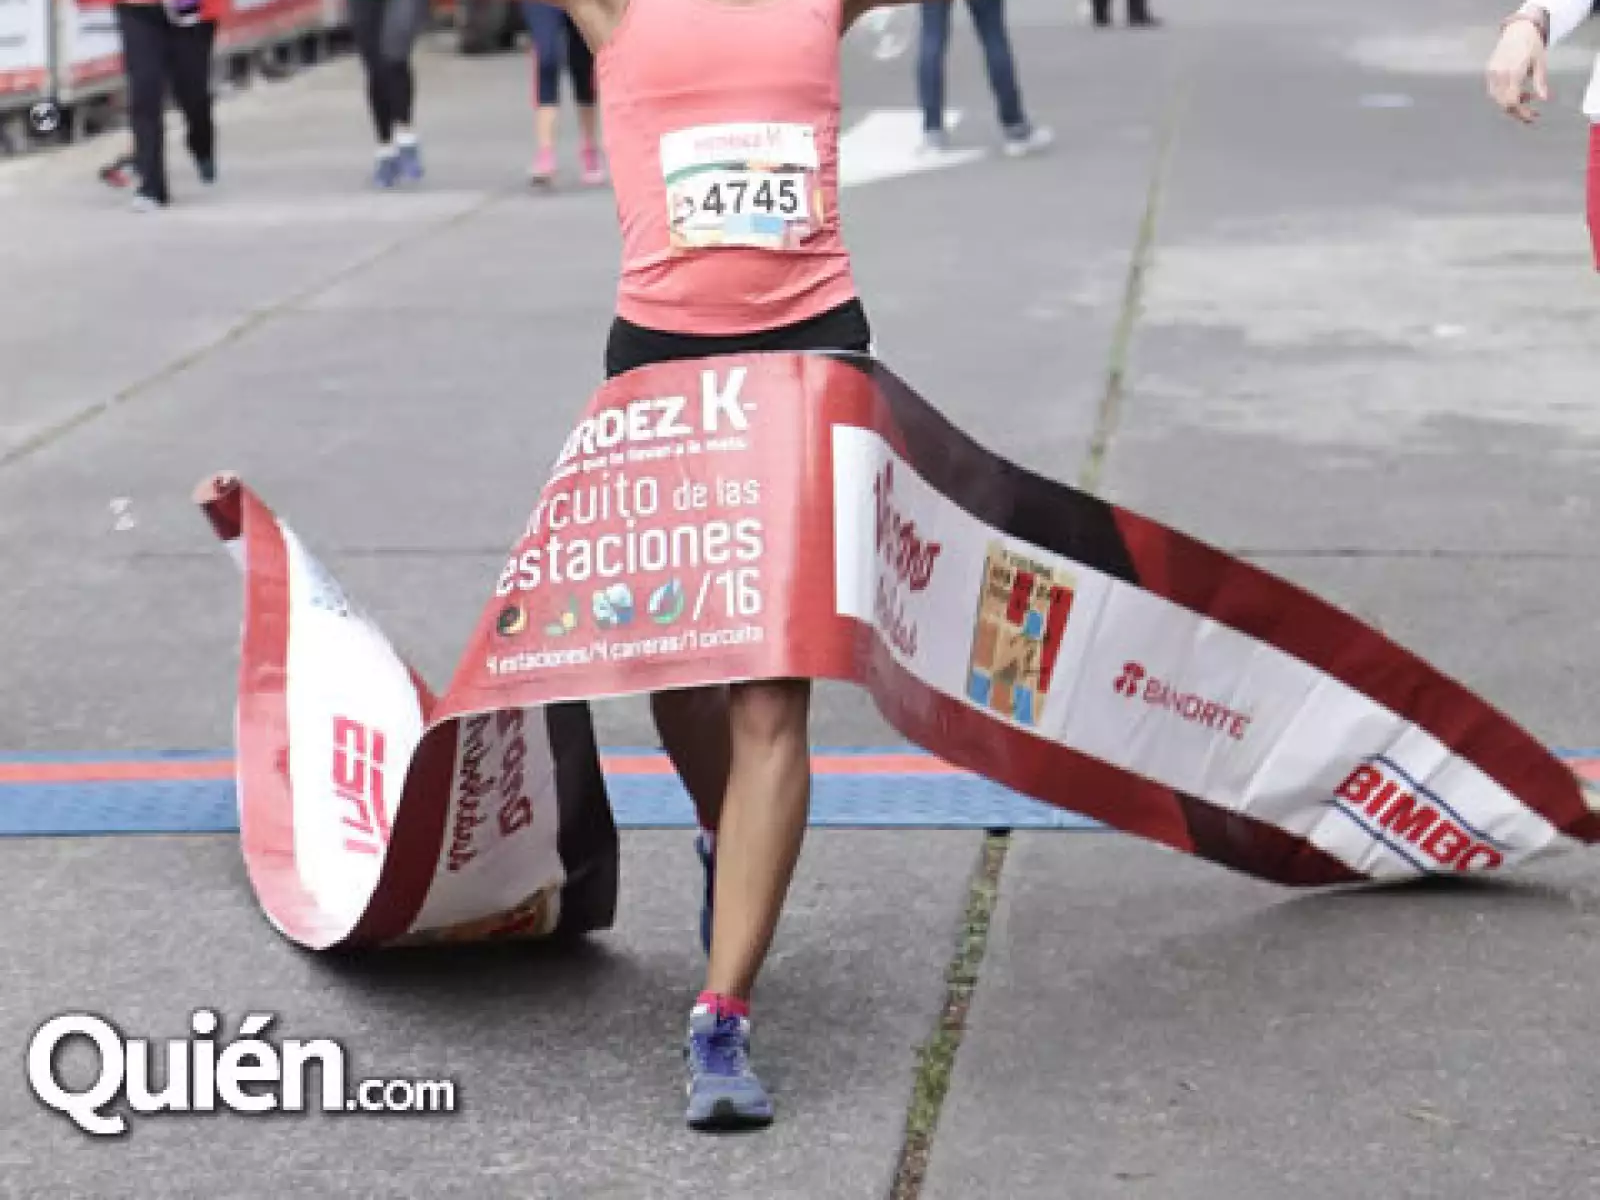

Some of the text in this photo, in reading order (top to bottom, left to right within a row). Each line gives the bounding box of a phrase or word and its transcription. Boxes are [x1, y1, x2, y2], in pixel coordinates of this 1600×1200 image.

[702, 179, 799, 216] 4745
[701, 366, 749, 432] K
[673, 476, 708, 511] de
[716, 474, 761, 507] las
[496, 515, 765, 598] estaciones
[692, 568, 763, 621] /16
